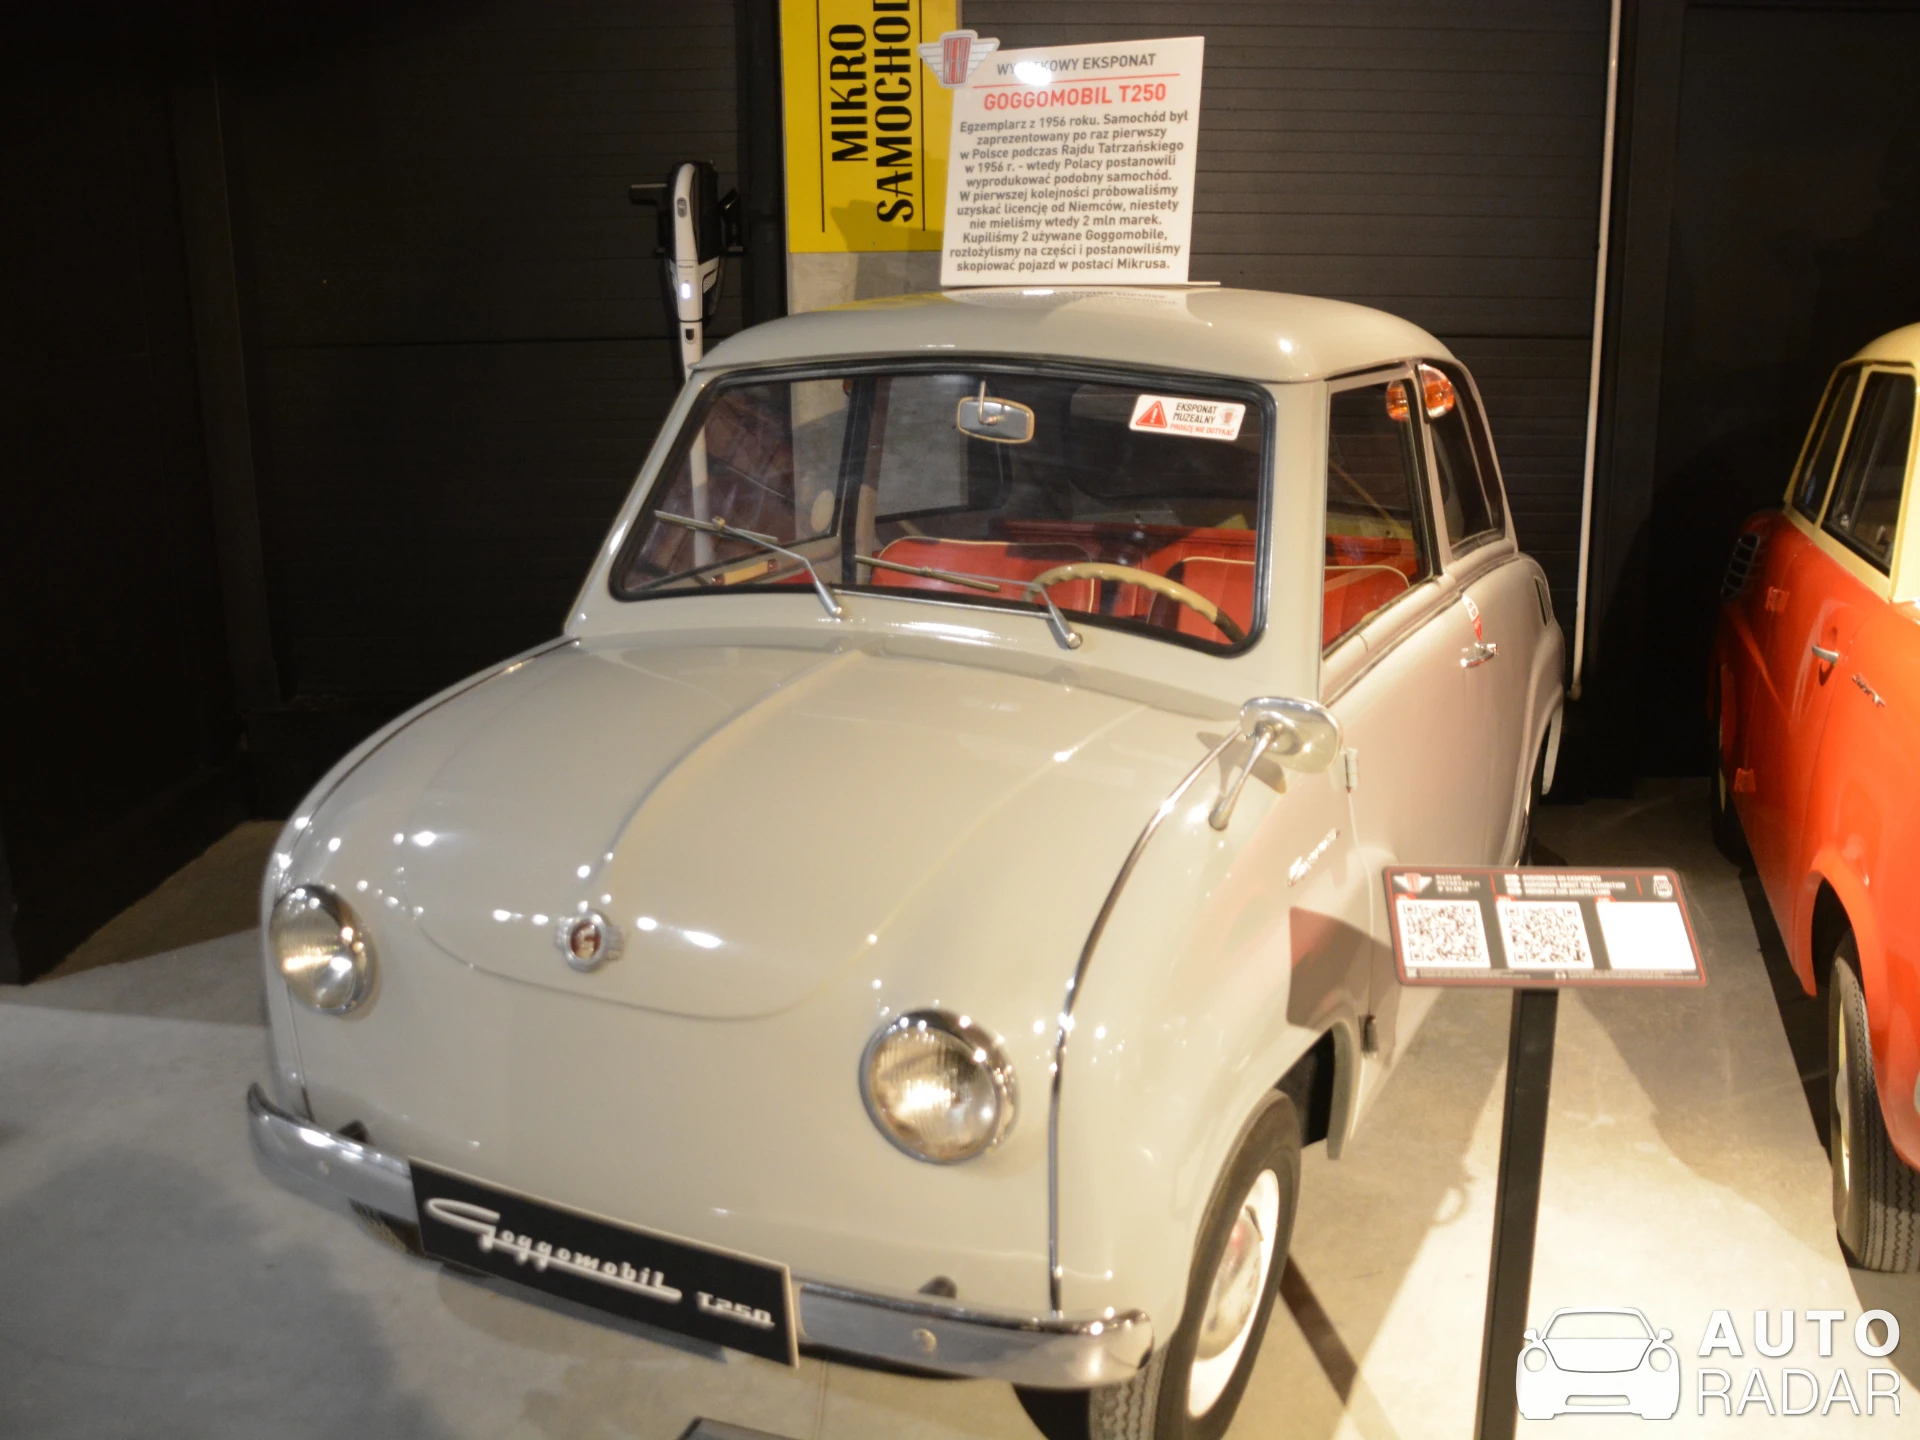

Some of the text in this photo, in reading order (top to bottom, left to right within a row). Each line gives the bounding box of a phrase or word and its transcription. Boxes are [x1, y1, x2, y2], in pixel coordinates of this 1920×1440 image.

[997, 53, 1156, 75] WYKOWY EKSPONAT
[829, 24, 868, 161] MIKRO
[984, 82, 1167, 110] GOGGOMOBIL T250
[960, 110, 1188, 134] Egzemplarz z 1956 roku. Samochód był
[977, 128, 1167, 147] zaprezentowany po raz pierwszy
[960, 141, 1183, 160] w Polsce podczas Rajdu Tatrzańskiego
[978, 162, 1003, 172] 1956
[1007, 164, 1014, 172] r.
[1026, 160, 1061, 172] wtedy
[1064, 158, 1103, 170] Polacy
[1106, 155, 1176, 169] postanowili
[966, 169, 1172, 189] wyprodukować podobny samochód.
[959, 184, 1179, 204] W pierwszej kolejności próbowaliśmy
[957, 200, 1180, 218] uzyskać licencję od Niemców, niestety
[970, 214, 1162, 230] nie mieliśmy wtedy 2 mln marek.
[962, 228, 1168, 245] Kupiliśmy 2 używane Goggomobile,
[1024, 248, 1038, 256] na
[1040, 244, 1076, 258] części
[1080, 244, 1082, 255] i
[1086, 242, 1181, 258] postanowiliśmy
[956, 258, 1170, 274] skopiować pojazd w postaci Mikrusa.
[1176, 402, 1217, 414] EKSPONAT
[1173, 413, 1216, 424] MUZEALNY
[424, 1198, 775, 1328] Goggomobil T250
